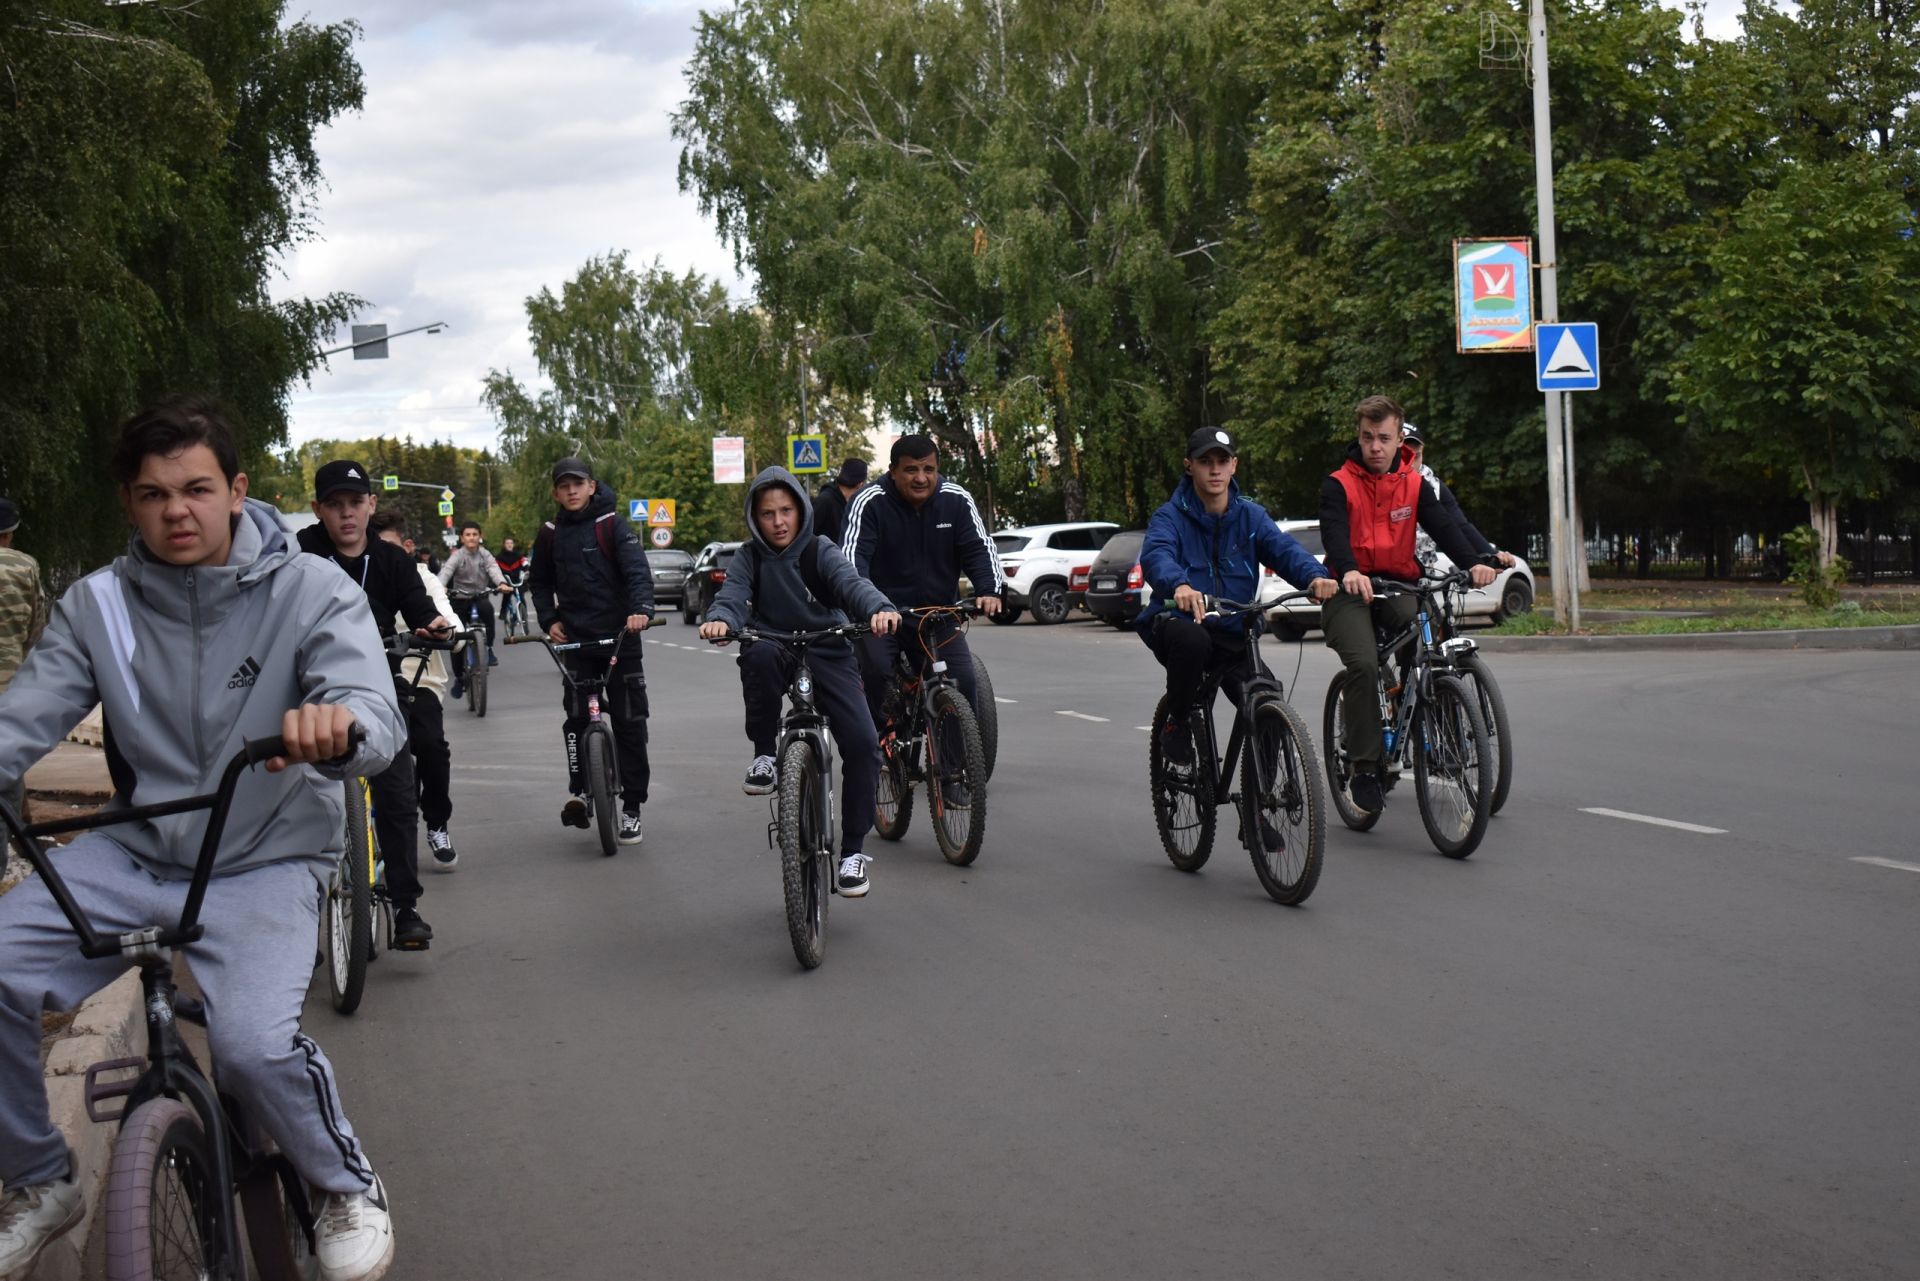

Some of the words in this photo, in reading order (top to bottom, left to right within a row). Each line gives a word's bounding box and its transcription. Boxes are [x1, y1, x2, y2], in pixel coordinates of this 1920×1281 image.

[656, 532, 668, 541] 40
[228, 676, 256, 689] adid
[567, 732, 578, 773] CHENLH
